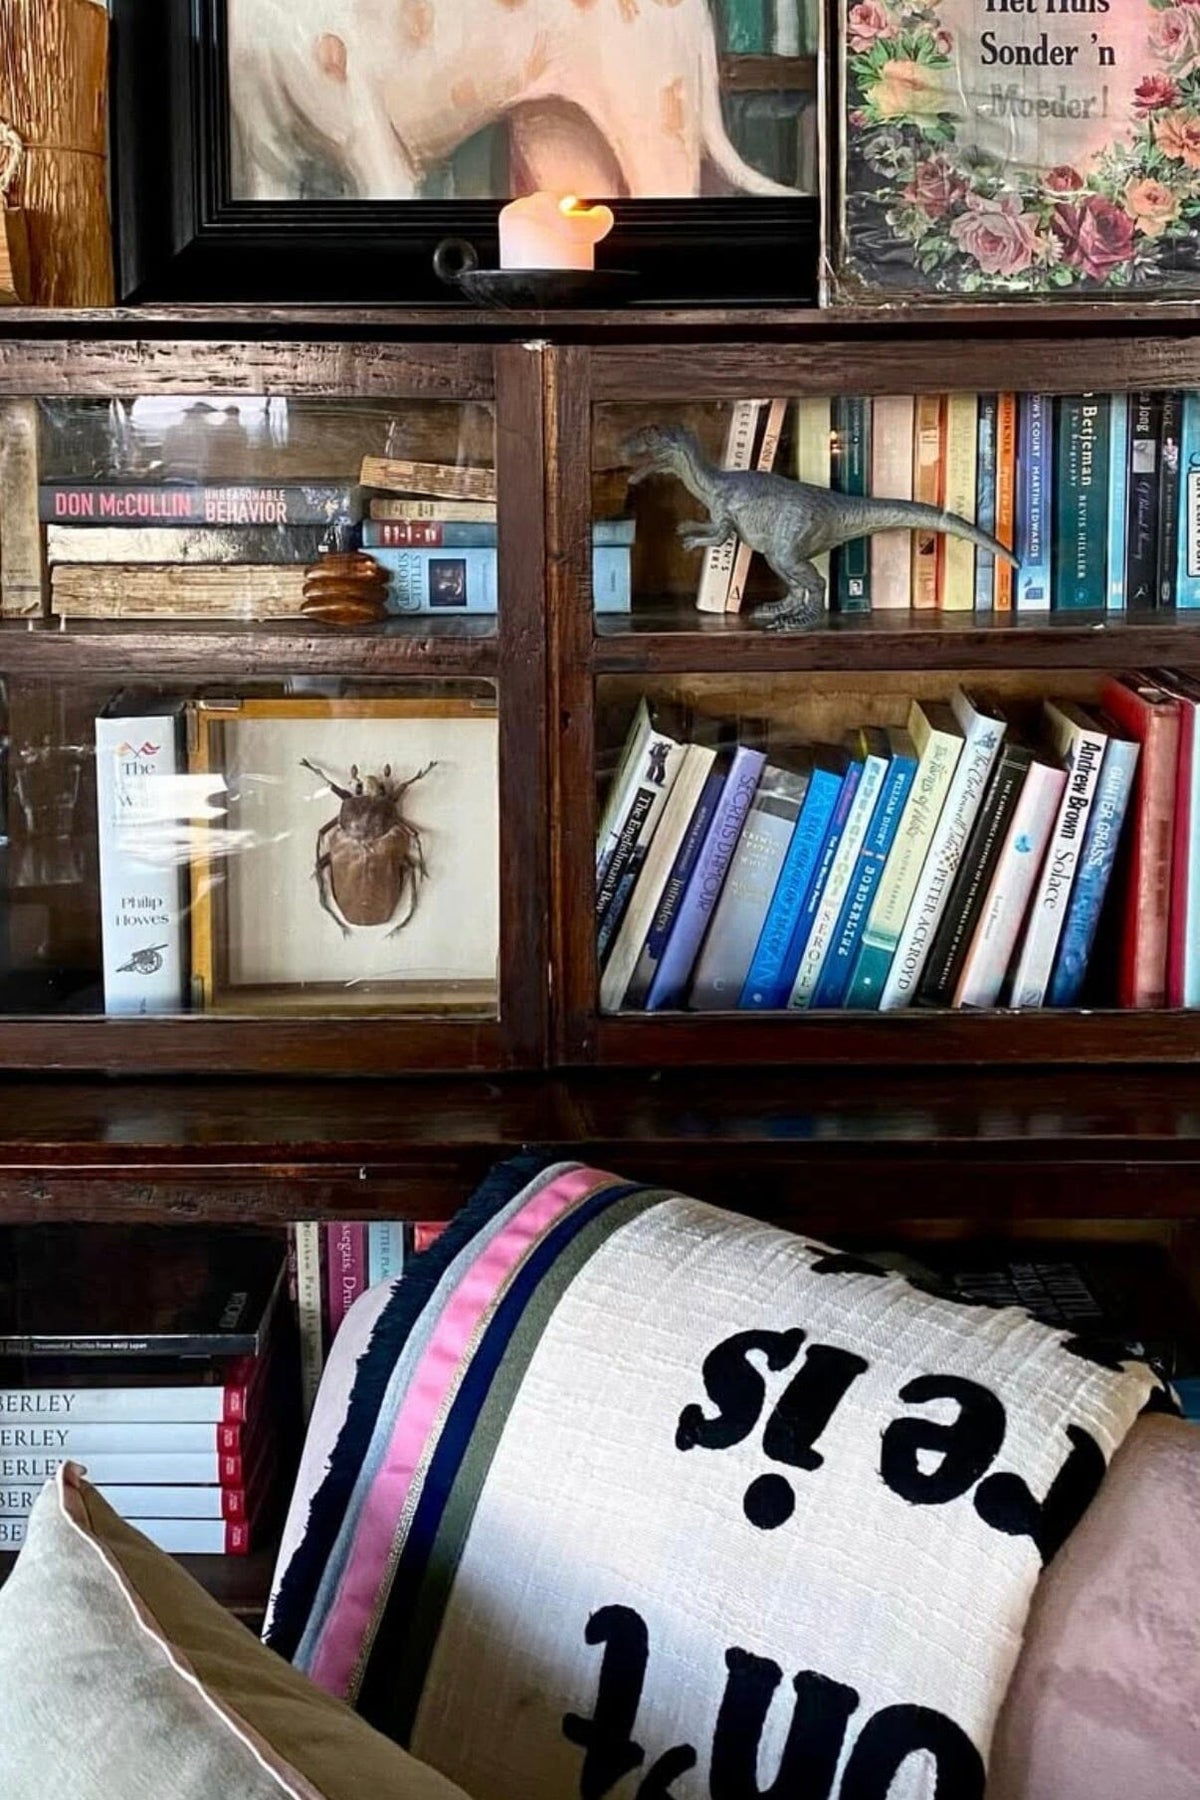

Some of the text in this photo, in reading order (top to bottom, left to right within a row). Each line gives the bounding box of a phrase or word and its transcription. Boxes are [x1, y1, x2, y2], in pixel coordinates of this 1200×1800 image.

[981, 31, 1115, 65] Sonder 'n
[1031, 421, 1040, 457] COURT
[1137, 405, 1151, 432] Jong
[1078, 406, 1098, 486] Betjeman
[54, 492, 191, 517] DON McCULLIN
[1031, 465, 1039, 504] MARTIN
[204, 500, 288, 523] BEHAVIOR
[1030, 508, 1038, 557] EDWARDS
[710, 548, 721, 569] ERS
[1077, 495, 1087, 579] BEVIS HILLIER
[122, 761, 155, 776] The
[1071, 740, 1101, 795] Andrew
[631, 793, 651, 820] The
[720, 774, 755, 841] SECRETS
[1060, 794, 1088, 841] Brown
[602, 818, 640, 890] Englishman's
[1087, 820, 1111, 867] GRASS
[921, 866, 948, 915] PETER
[1042, 848, 1076, 910] Solace
[121, 896, 163, 914] Philip
[652, 876, 683, 933] Intruders
[895, 915, 932, 992] ACKROYD
[675, 1328, 870, 1529] is
